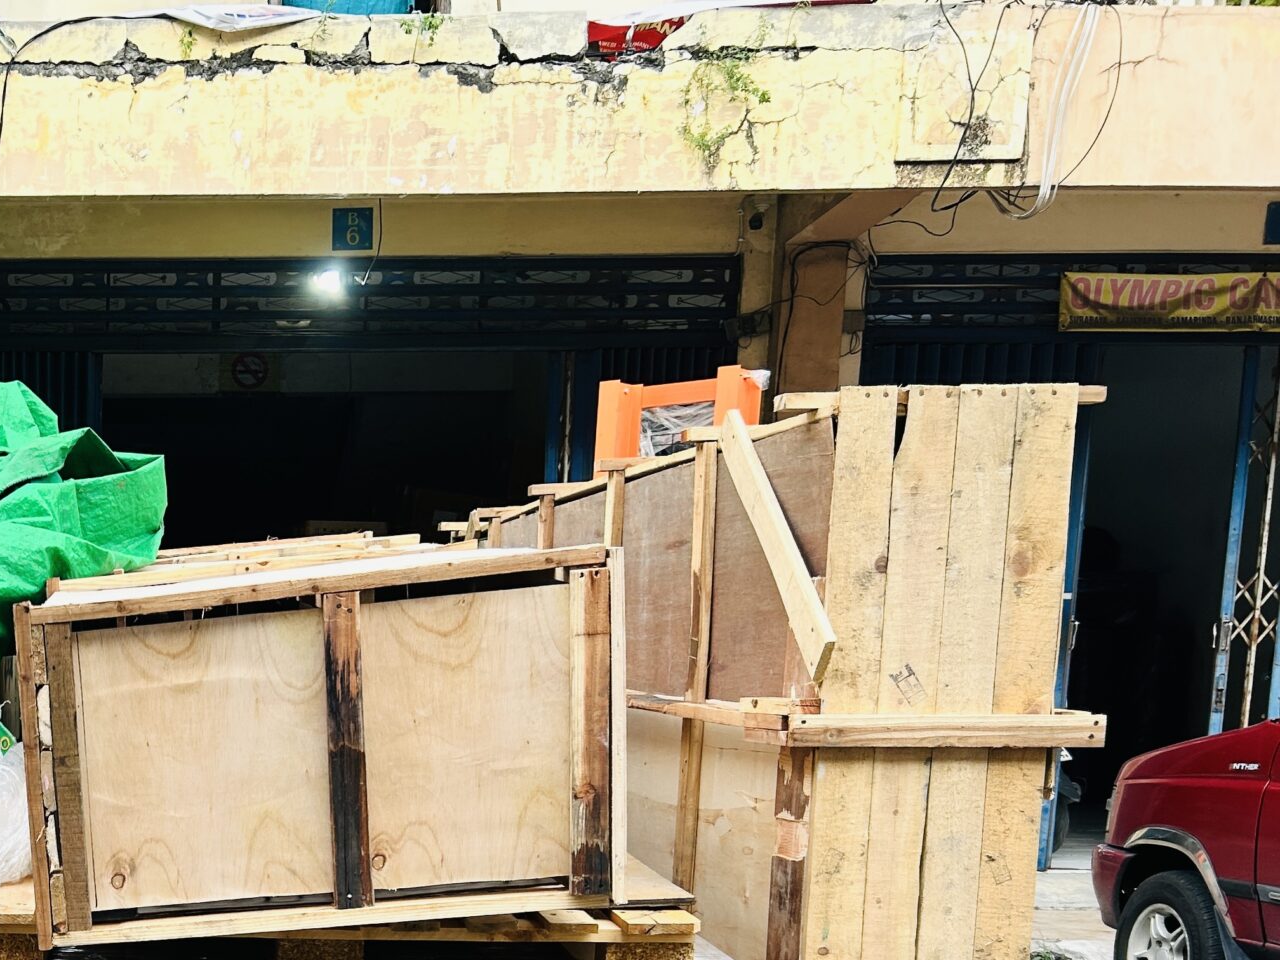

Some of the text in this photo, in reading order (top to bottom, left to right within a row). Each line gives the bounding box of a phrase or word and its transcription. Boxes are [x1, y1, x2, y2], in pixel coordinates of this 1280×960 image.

[348, 212, 359, 226] B
[346, 227, 360, 246] 6
[1070, 276, 1217, 312] OLYMPIC
